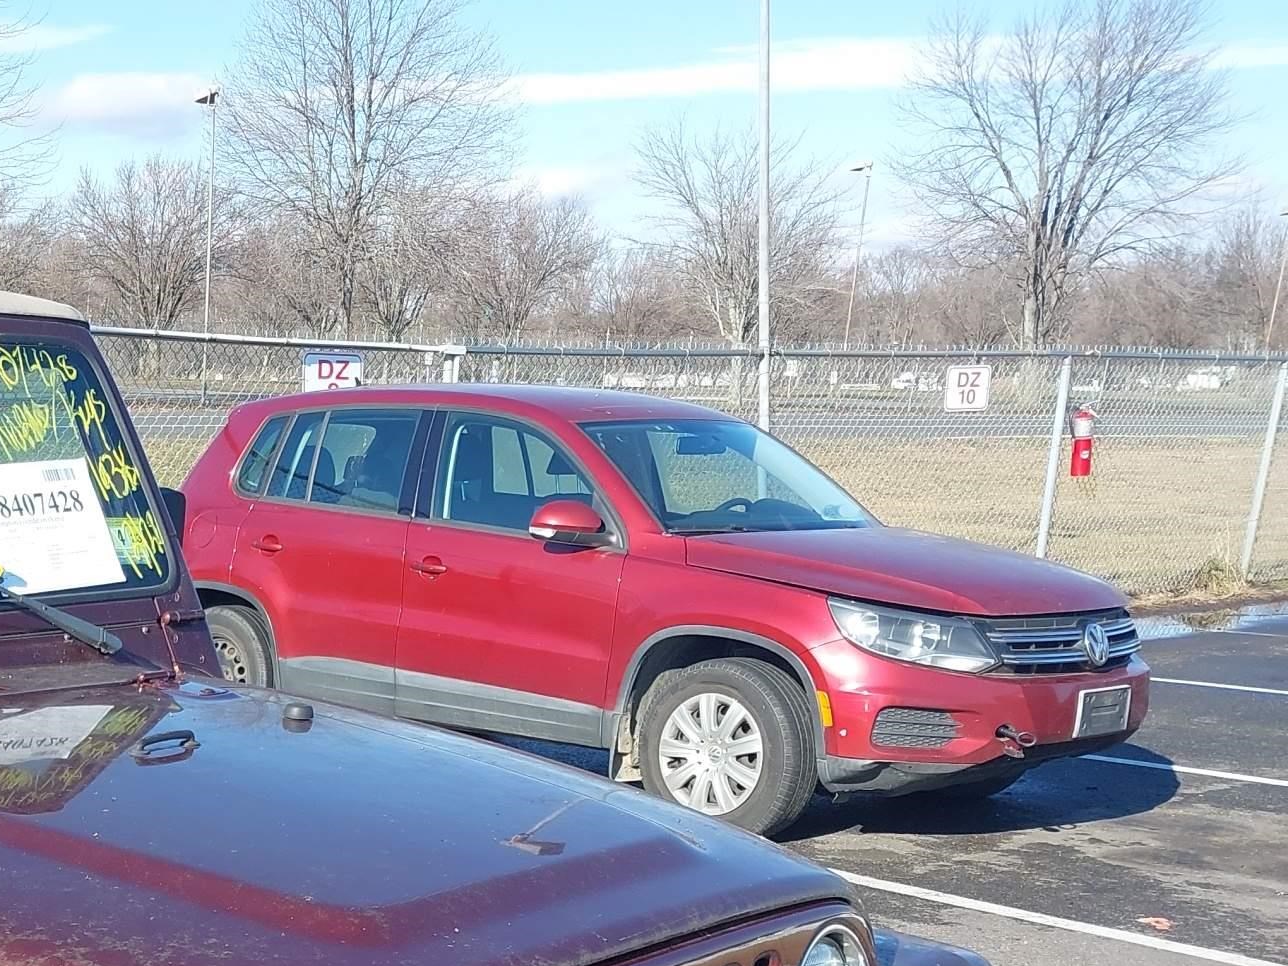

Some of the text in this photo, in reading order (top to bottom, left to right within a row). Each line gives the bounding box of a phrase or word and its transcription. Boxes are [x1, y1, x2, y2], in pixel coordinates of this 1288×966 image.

[317, 359, 350, 380] DZ
[957, 371, 982, 388] DZ
[959, 389, 976, 405] 10
